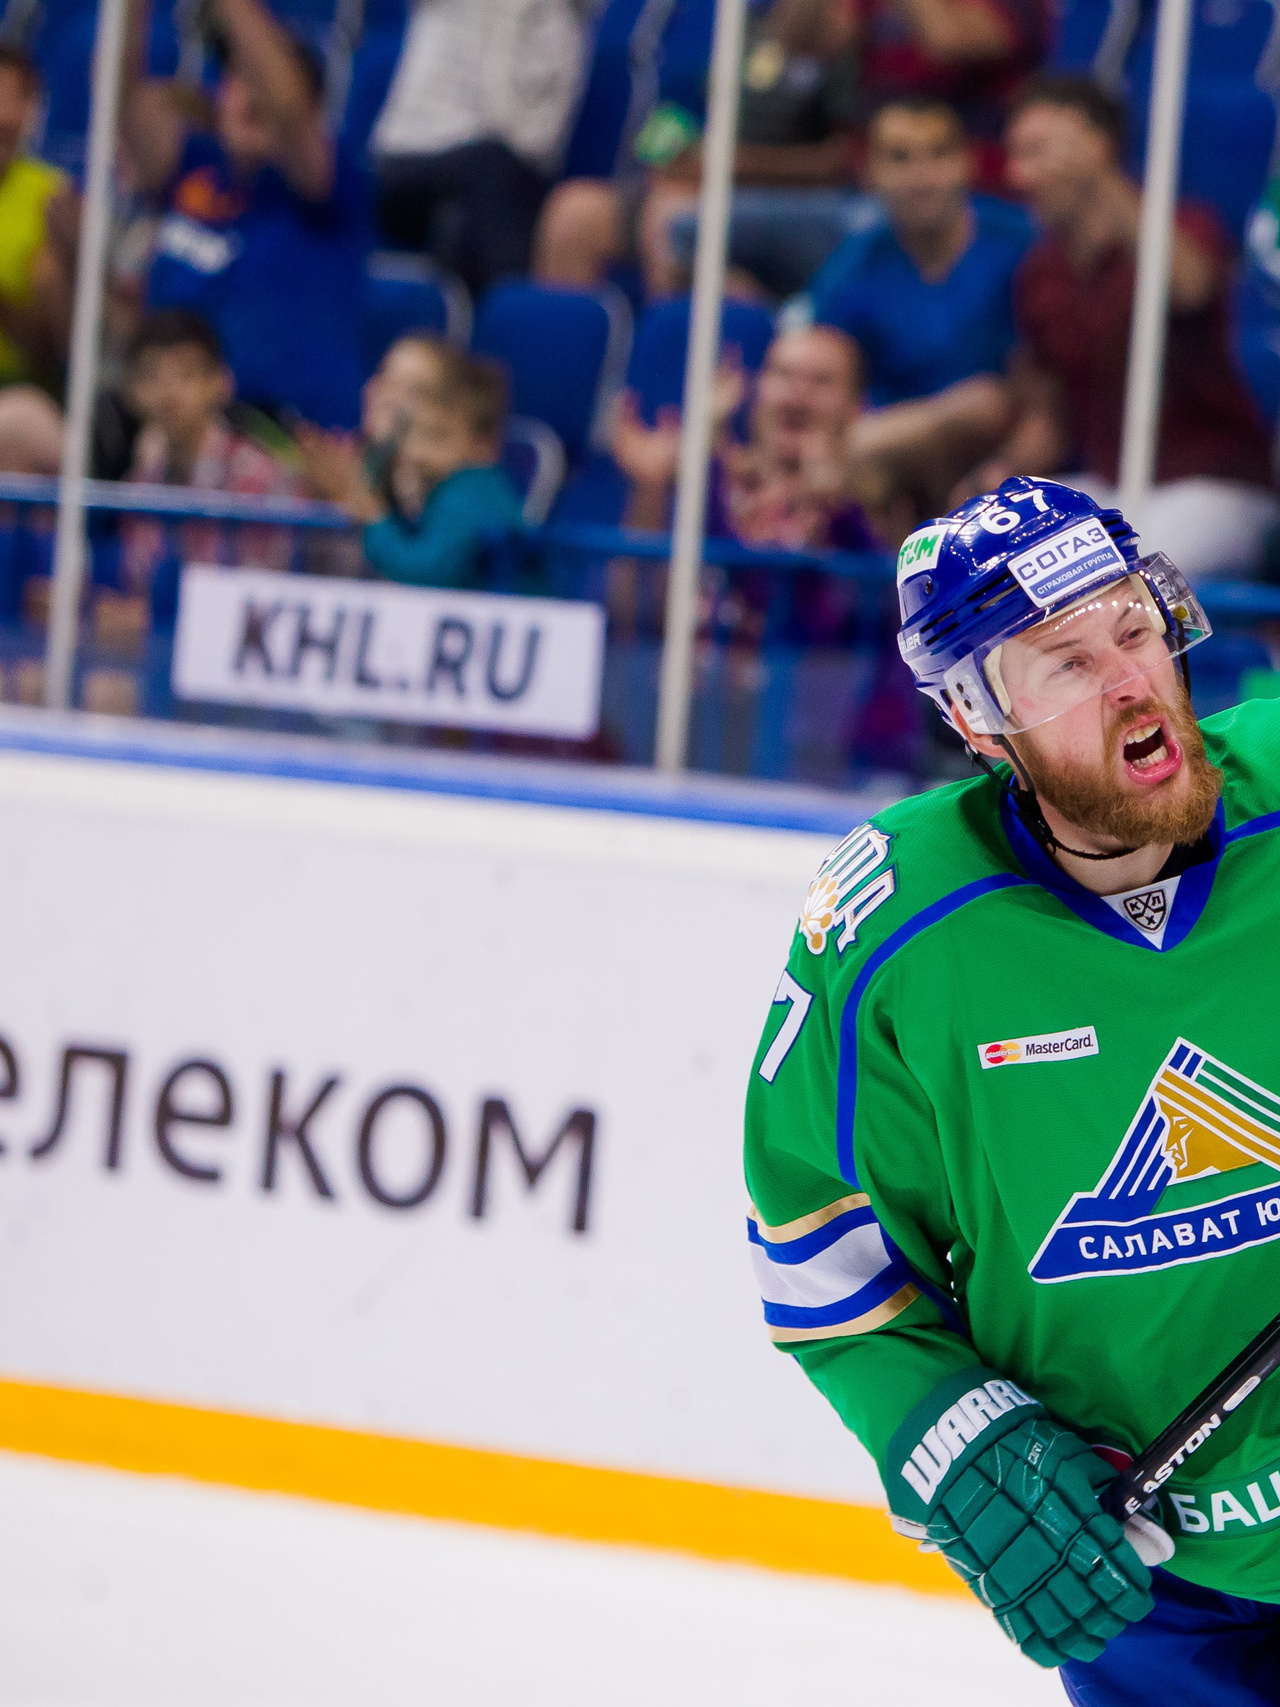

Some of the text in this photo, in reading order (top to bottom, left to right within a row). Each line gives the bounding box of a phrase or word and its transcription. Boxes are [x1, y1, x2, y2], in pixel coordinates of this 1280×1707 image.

[980, 489, 1050, 534] 67
[1016, 527, 1106, 580] СОГАЗ
[1036, 552, 1114, 595] СТРАХОВАЯ ГРУППА
[231, 600, 541, 702] KHL.RU
[1025, 1033, 1092, 1057] MasterCard
[0, 1030, 599, 1238] леком
[1078, 1210, 1242, 1262] САЛАВАТ
[1123, 1412, 1223, 1516] EASTON
